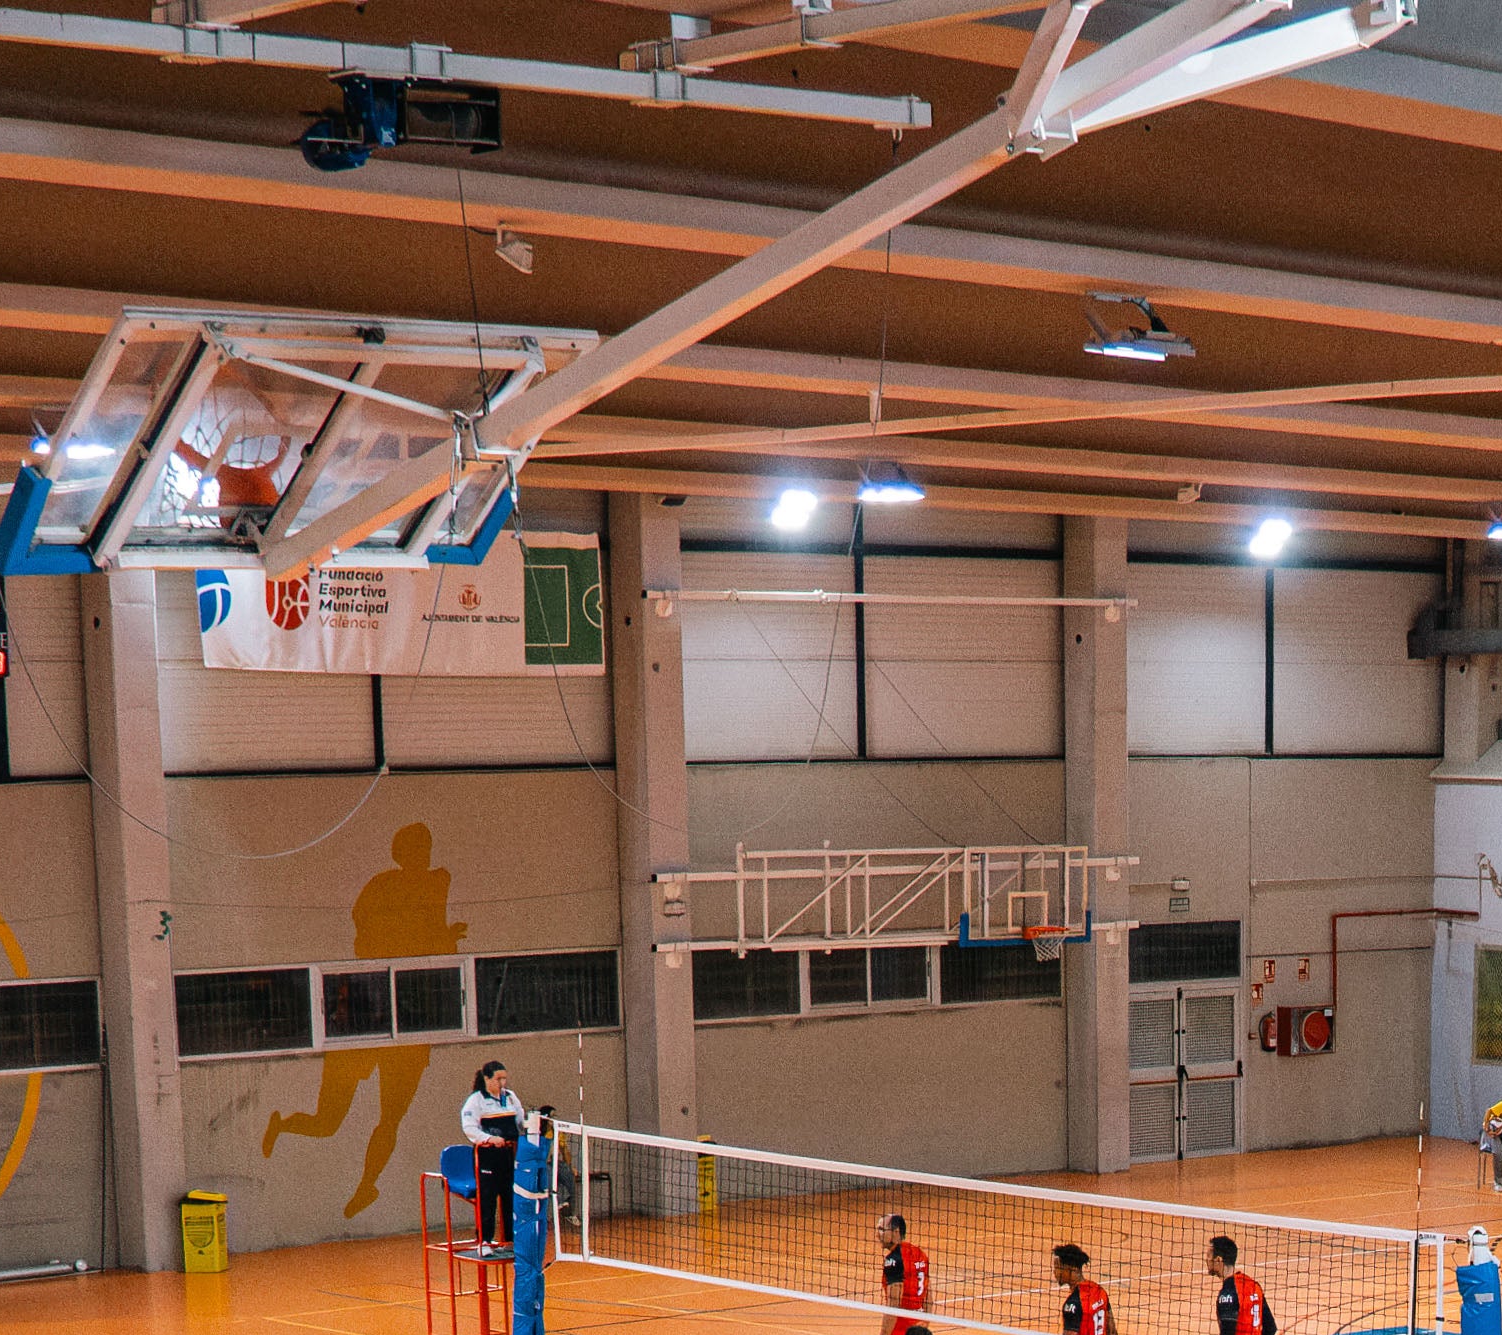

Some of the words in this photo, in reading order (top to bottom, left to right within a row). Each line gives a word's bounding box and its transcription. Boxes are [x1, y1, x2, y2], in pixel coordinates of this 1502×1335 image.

[319, 569, 384, 582] Fundació
[319, 583, 387, 600] Esportiva
[319, 599, 389, 617] Municipal
